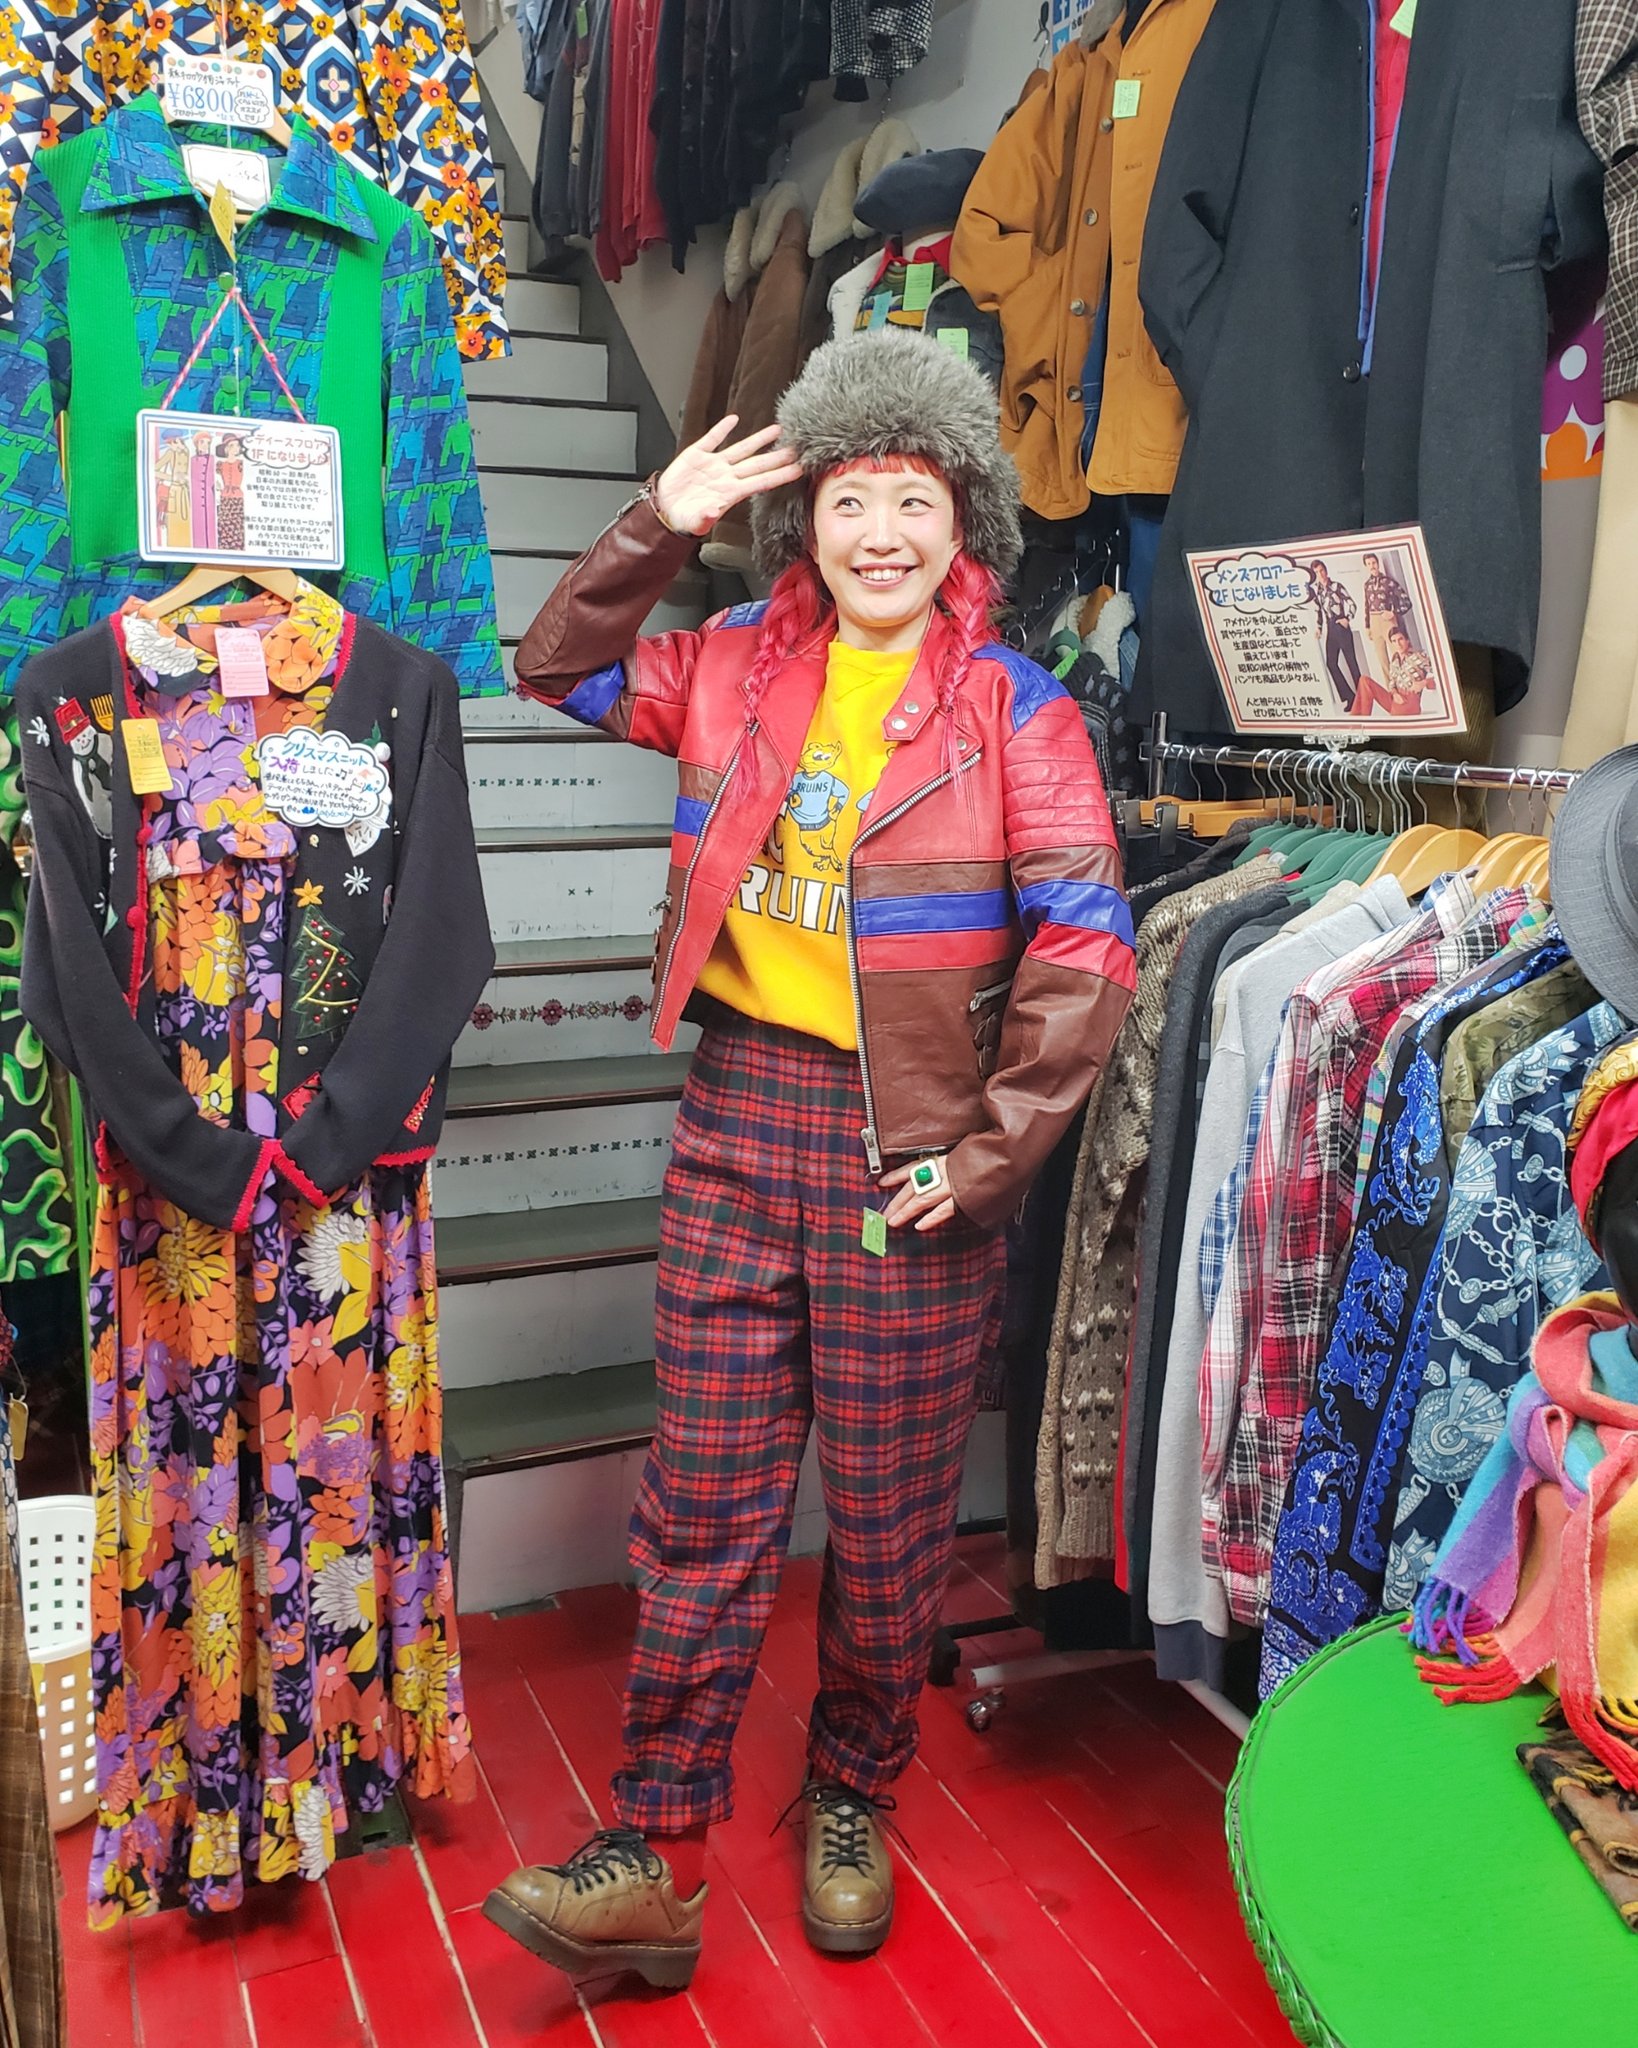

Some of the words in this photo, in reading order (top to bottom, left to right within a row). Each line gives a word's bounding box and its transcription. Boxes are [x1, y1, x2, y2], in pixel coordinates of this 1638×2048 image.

[168, 83, 234, 113] ¥6800
[1217, 564, 1296, 584] メンズフロアー
[1232, 583, 1302, 603] になりました
[1223, 614, 1299, 627] アメカジを中心とした
[281, 741, 368, 766] クリスマスニット
[797, 781, 828, 793] BRUINS
